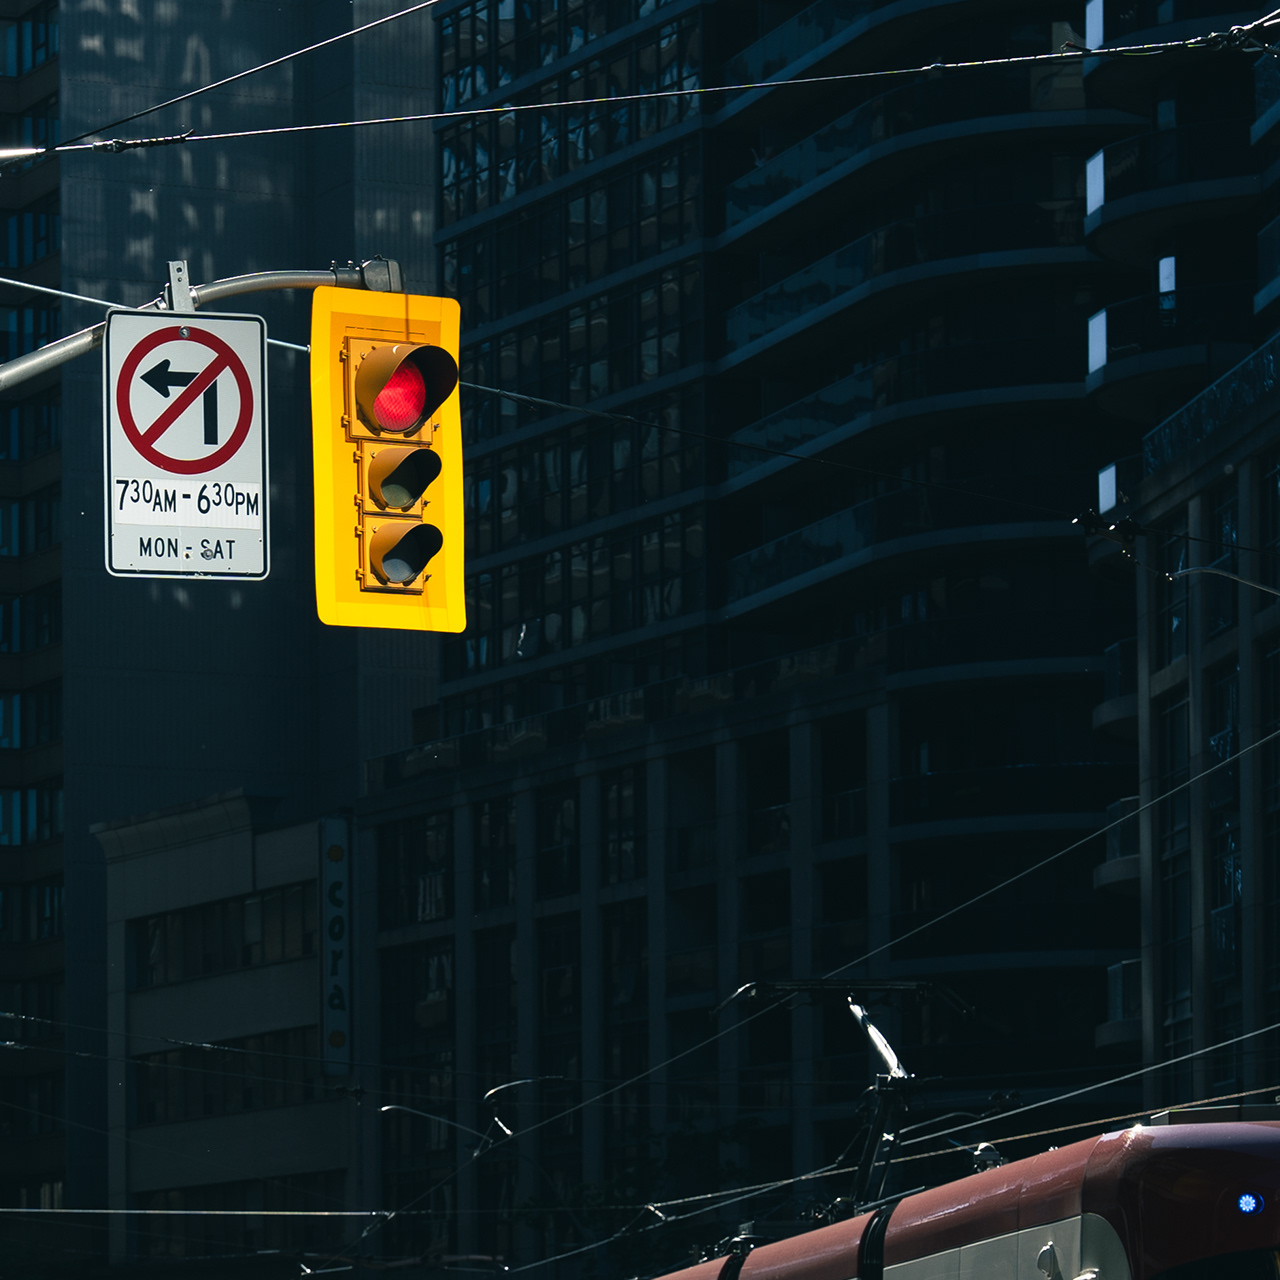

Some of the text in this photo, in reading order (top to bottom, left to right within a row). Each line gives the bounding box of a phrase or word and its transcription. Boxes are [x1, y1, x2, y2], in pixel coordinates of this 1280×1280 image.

[139, 537, 178, 558] MON
[200, 539, 235, 560] SAT
[328, 880, 346, 1012] Cora
